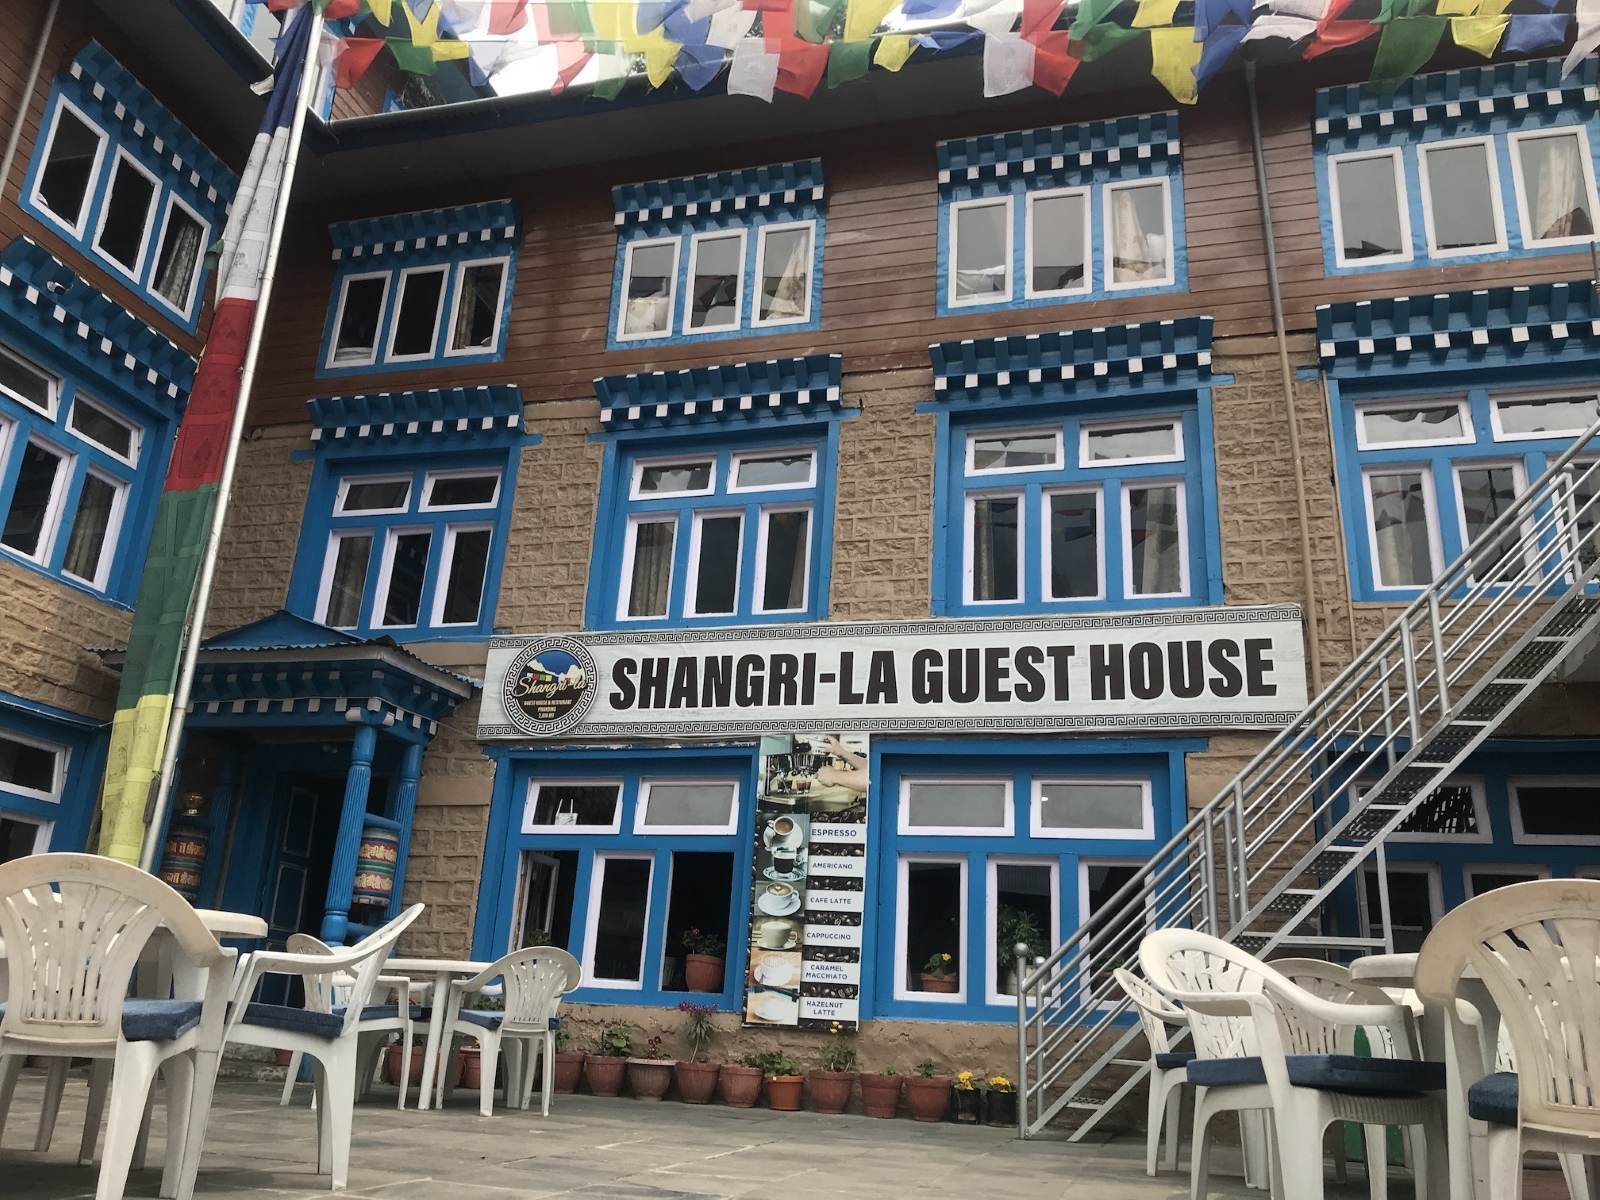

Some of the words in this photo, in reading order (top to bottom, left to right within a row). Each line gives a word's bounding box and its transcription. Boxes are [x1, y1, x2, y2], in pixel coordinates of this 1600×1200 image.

[609, 650, 899, 710] SHANGRI-LA
[911, 645, 1076, 704] GUEST
[1089, 638, 1277, 700] HOUSE
[811, 828, 857, 837] ESPRESSO
[812, 862, 853, 870] AMERICANO
[830, 897, 852, 905] LATTE
[806, 932, 851, 940] CAPPUCCINO
[810, 964, 844, 972] CARAMEL
[805, 972, 848, 980] MACCHIATO
[806, 1001, 844, 1009] HAZELNUT
[813, 1009, 836, 1017] LATTE
